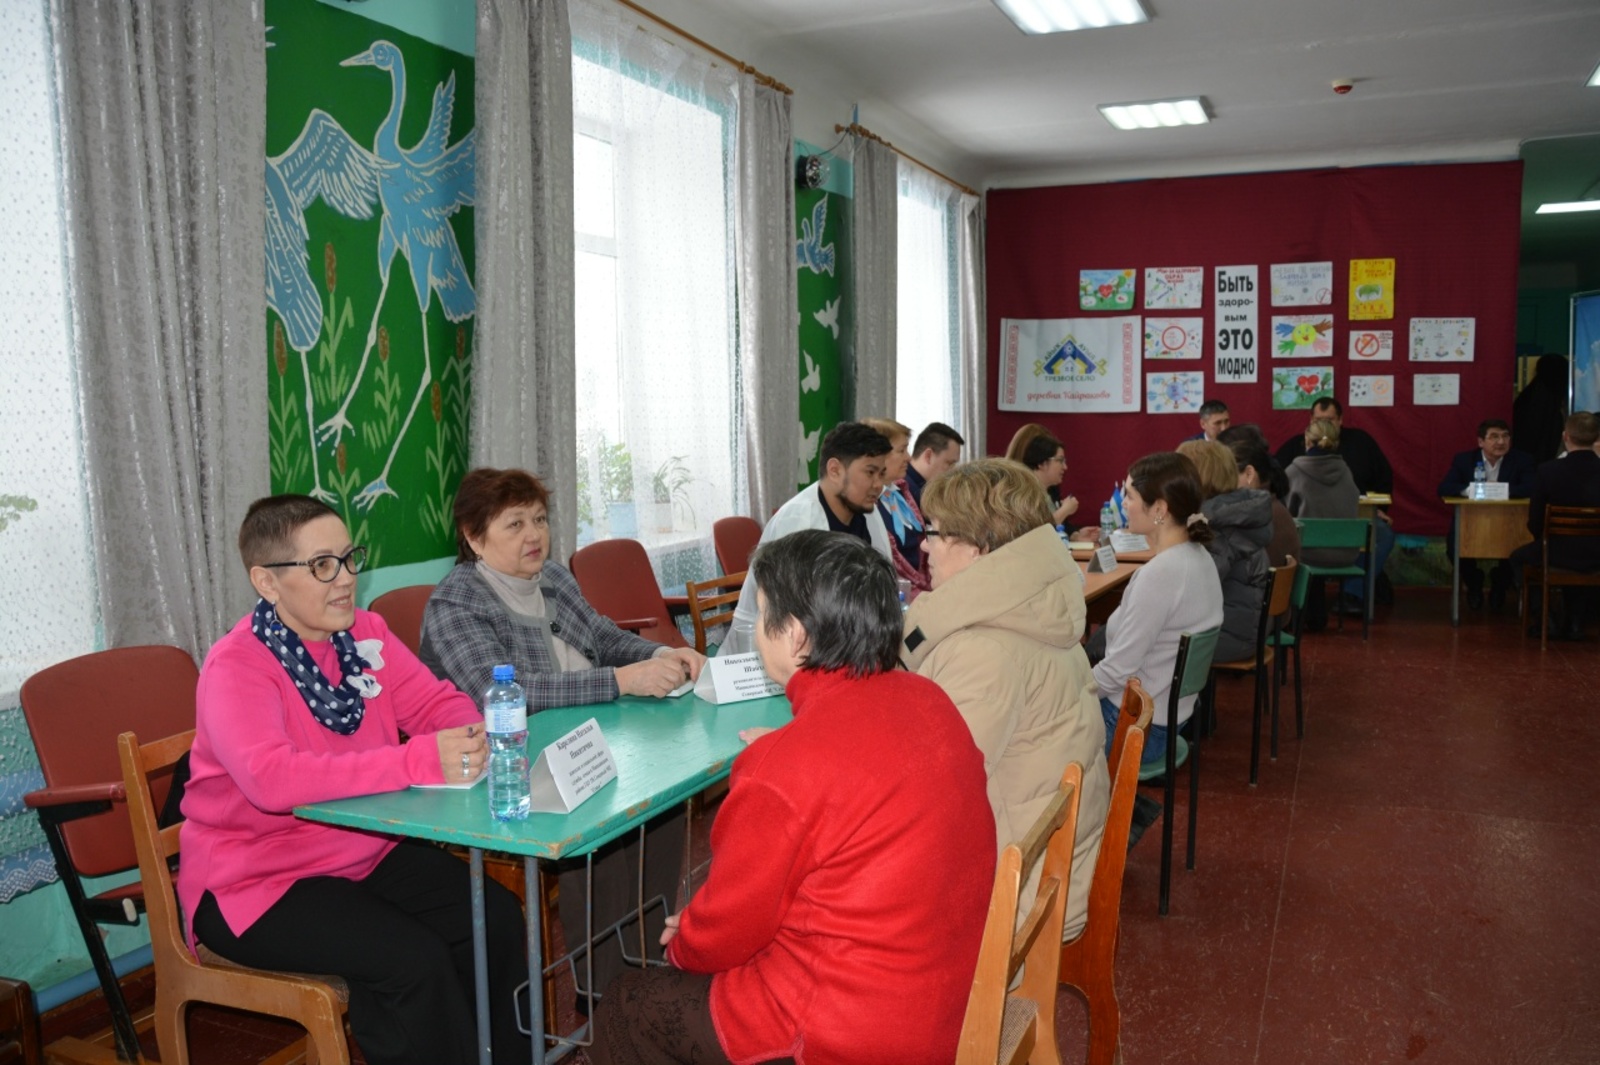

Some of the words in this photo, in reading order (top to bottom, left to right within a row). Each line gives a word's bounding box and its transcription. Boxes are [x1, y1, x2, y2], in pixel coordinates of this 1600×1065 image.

[1218, 270, 1253, 293] Быть
[1218, 298, 1254, 308] здоро-
[1224, 314, 1247, 322] вым
[1027, 391, 1061, 402] деревня
